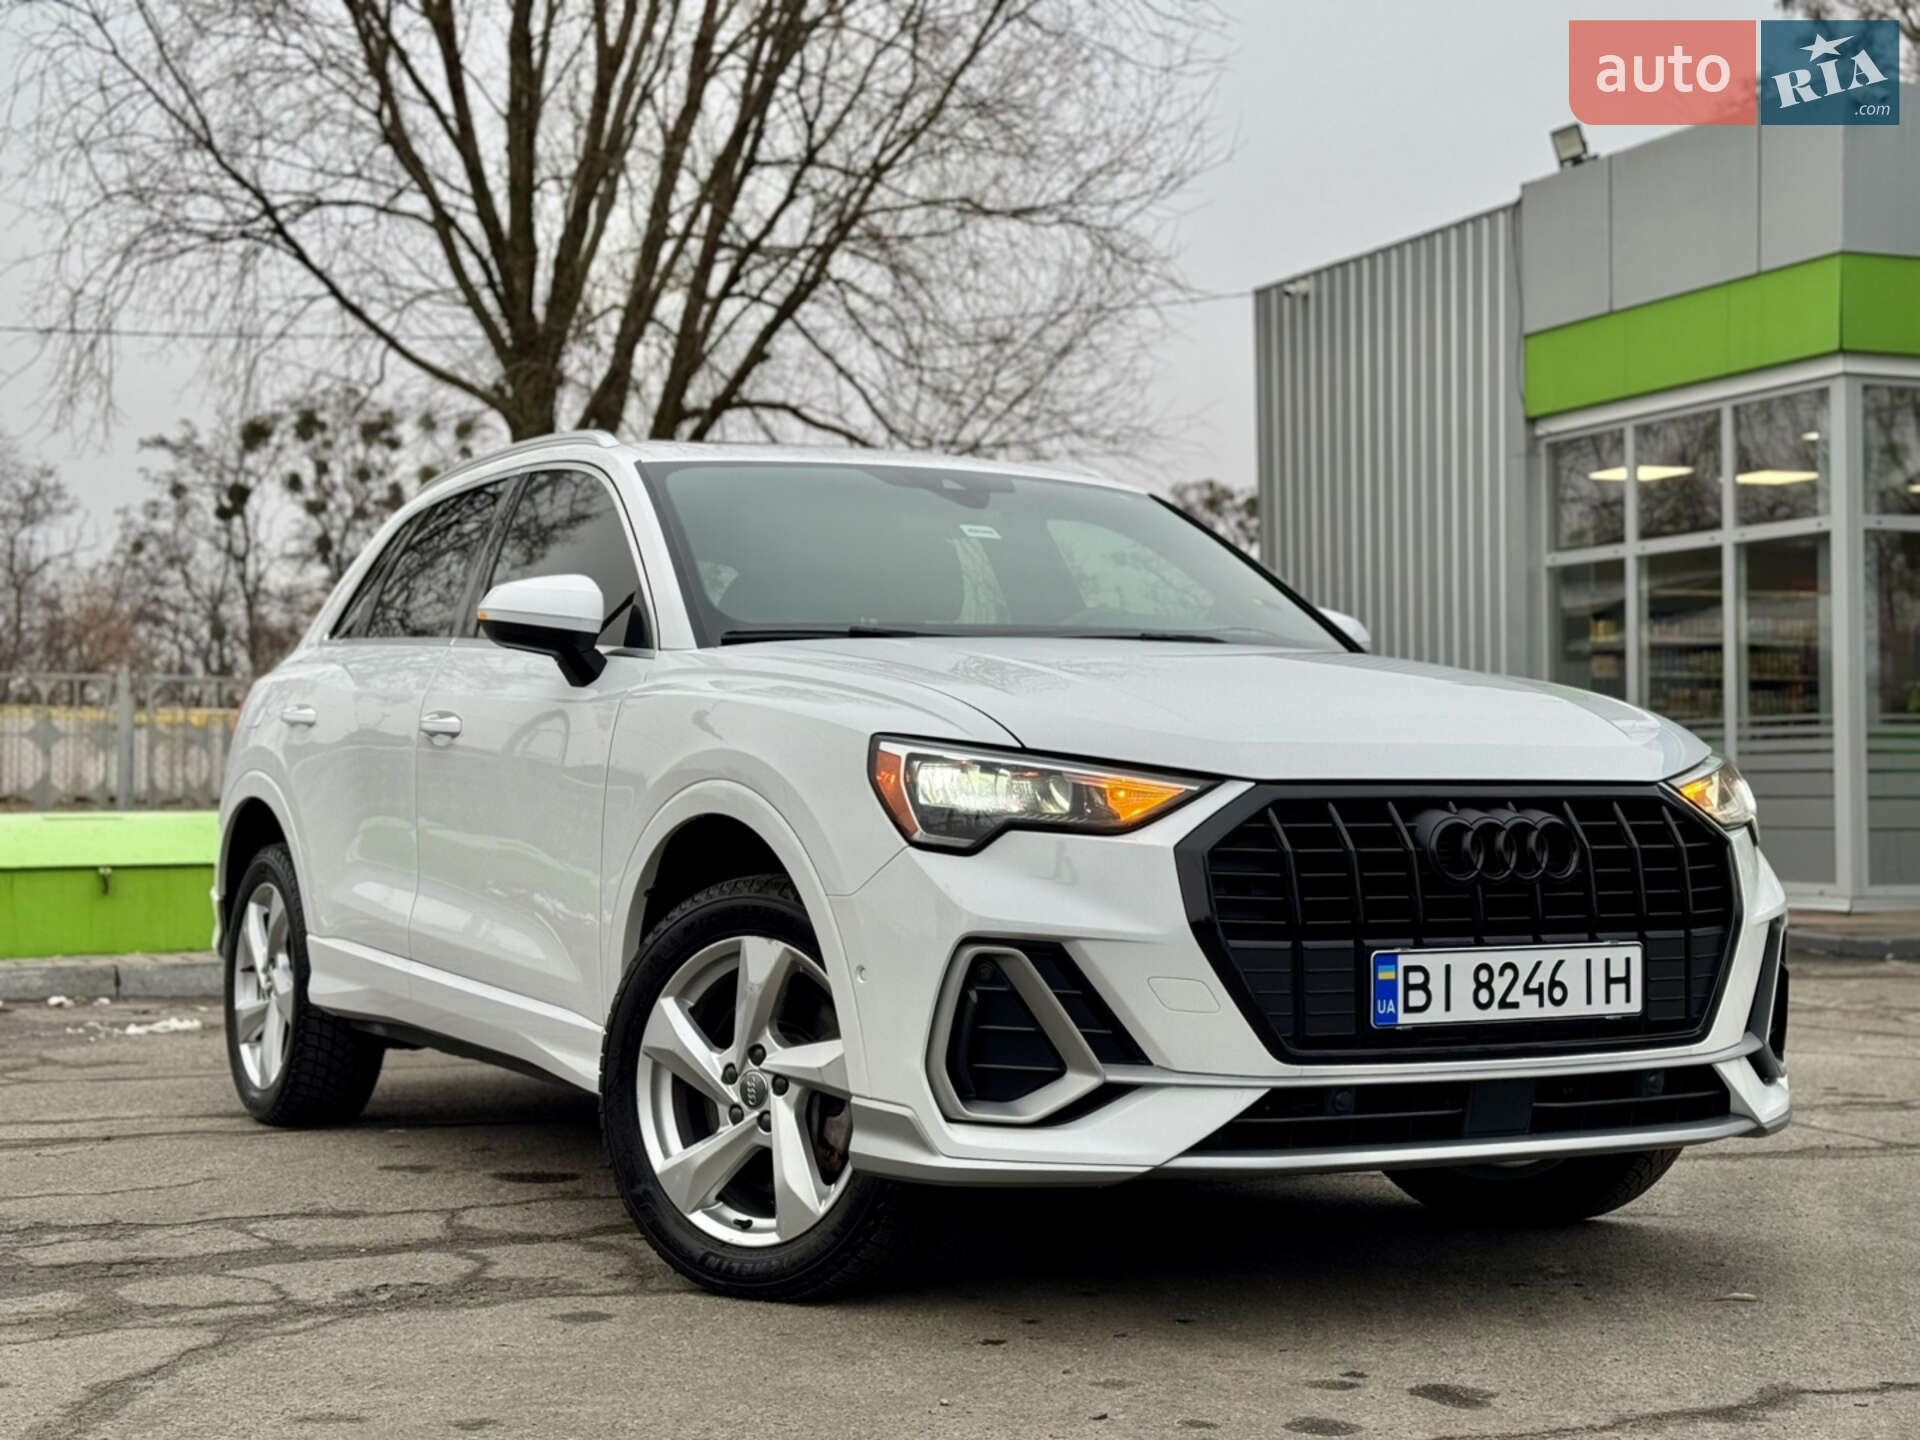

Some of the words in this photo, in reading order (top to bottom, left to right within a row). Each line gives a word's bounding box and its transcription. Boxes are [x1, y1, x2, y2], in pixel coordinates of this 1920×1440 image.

[1402, 964, 1452, 1014] BI
[1472, 959, 1568, 1011] 8246
[1585, 956, 1631, 1006] IH
[1377, 998, 1396, 1014] UA
[703, 1251, 805, 1276] ICHELIN
